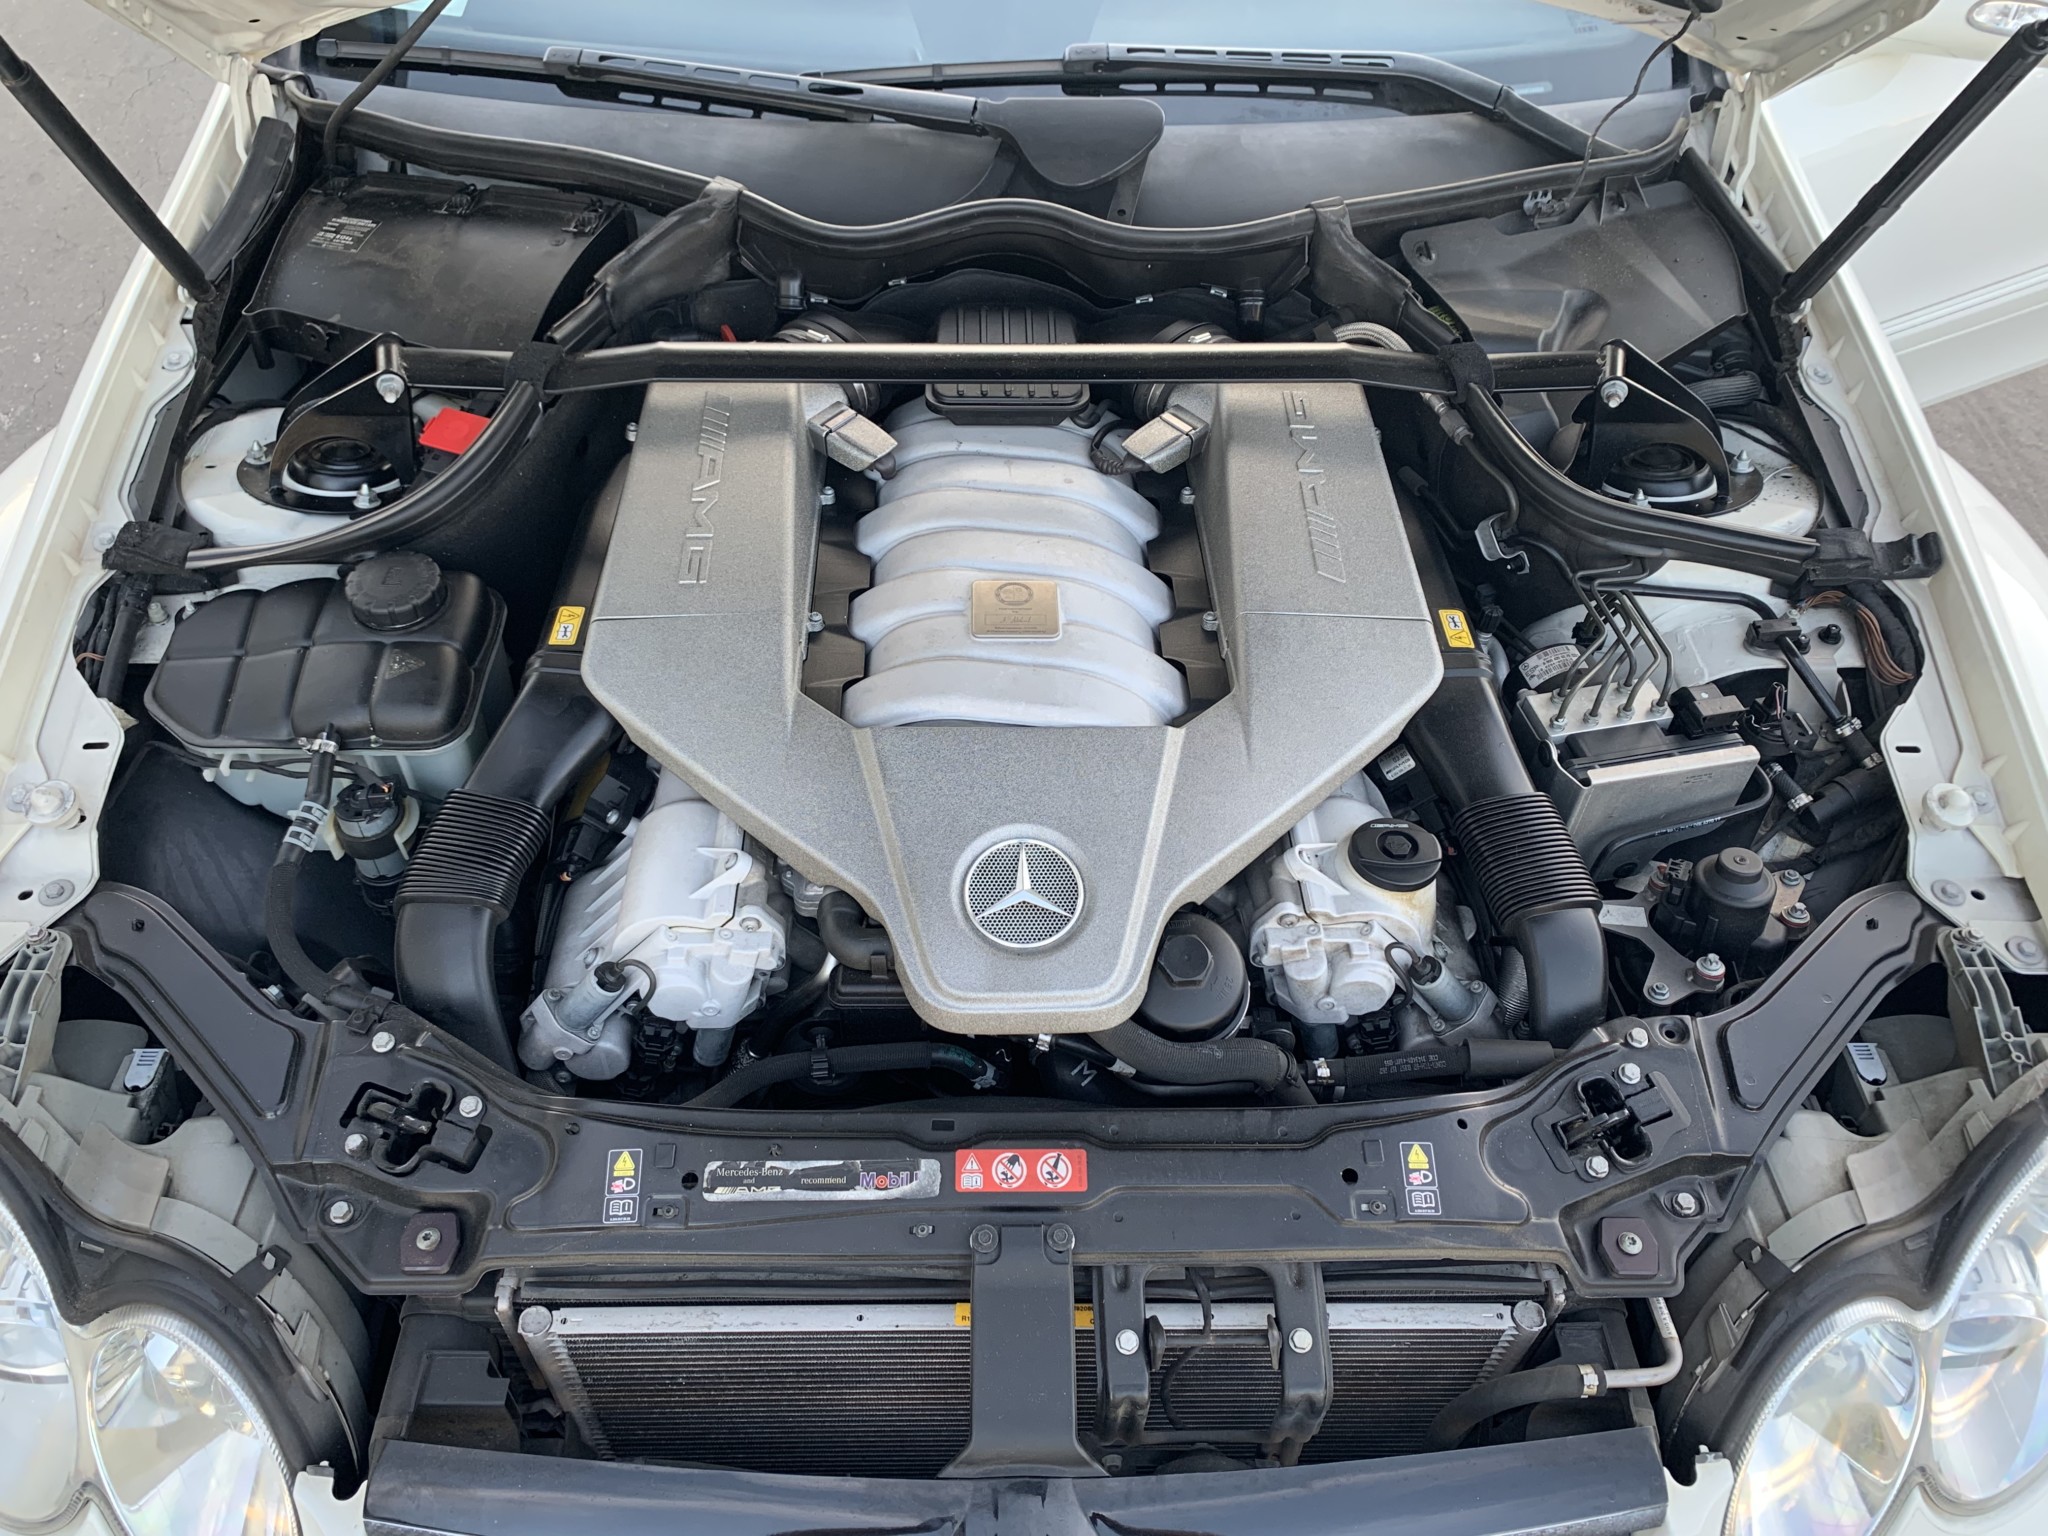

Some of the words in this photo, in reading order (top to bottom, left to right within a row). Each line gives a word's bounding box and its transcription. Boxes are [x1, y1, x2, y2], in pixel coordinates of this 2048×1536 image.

[679, 453, 724, 584] AMG
[716, 1167, 784, 1177] Mercedes-Benz
[801, 1176, 847, 1185] recommend
[860, 1171, 910, 1189] Mobil
